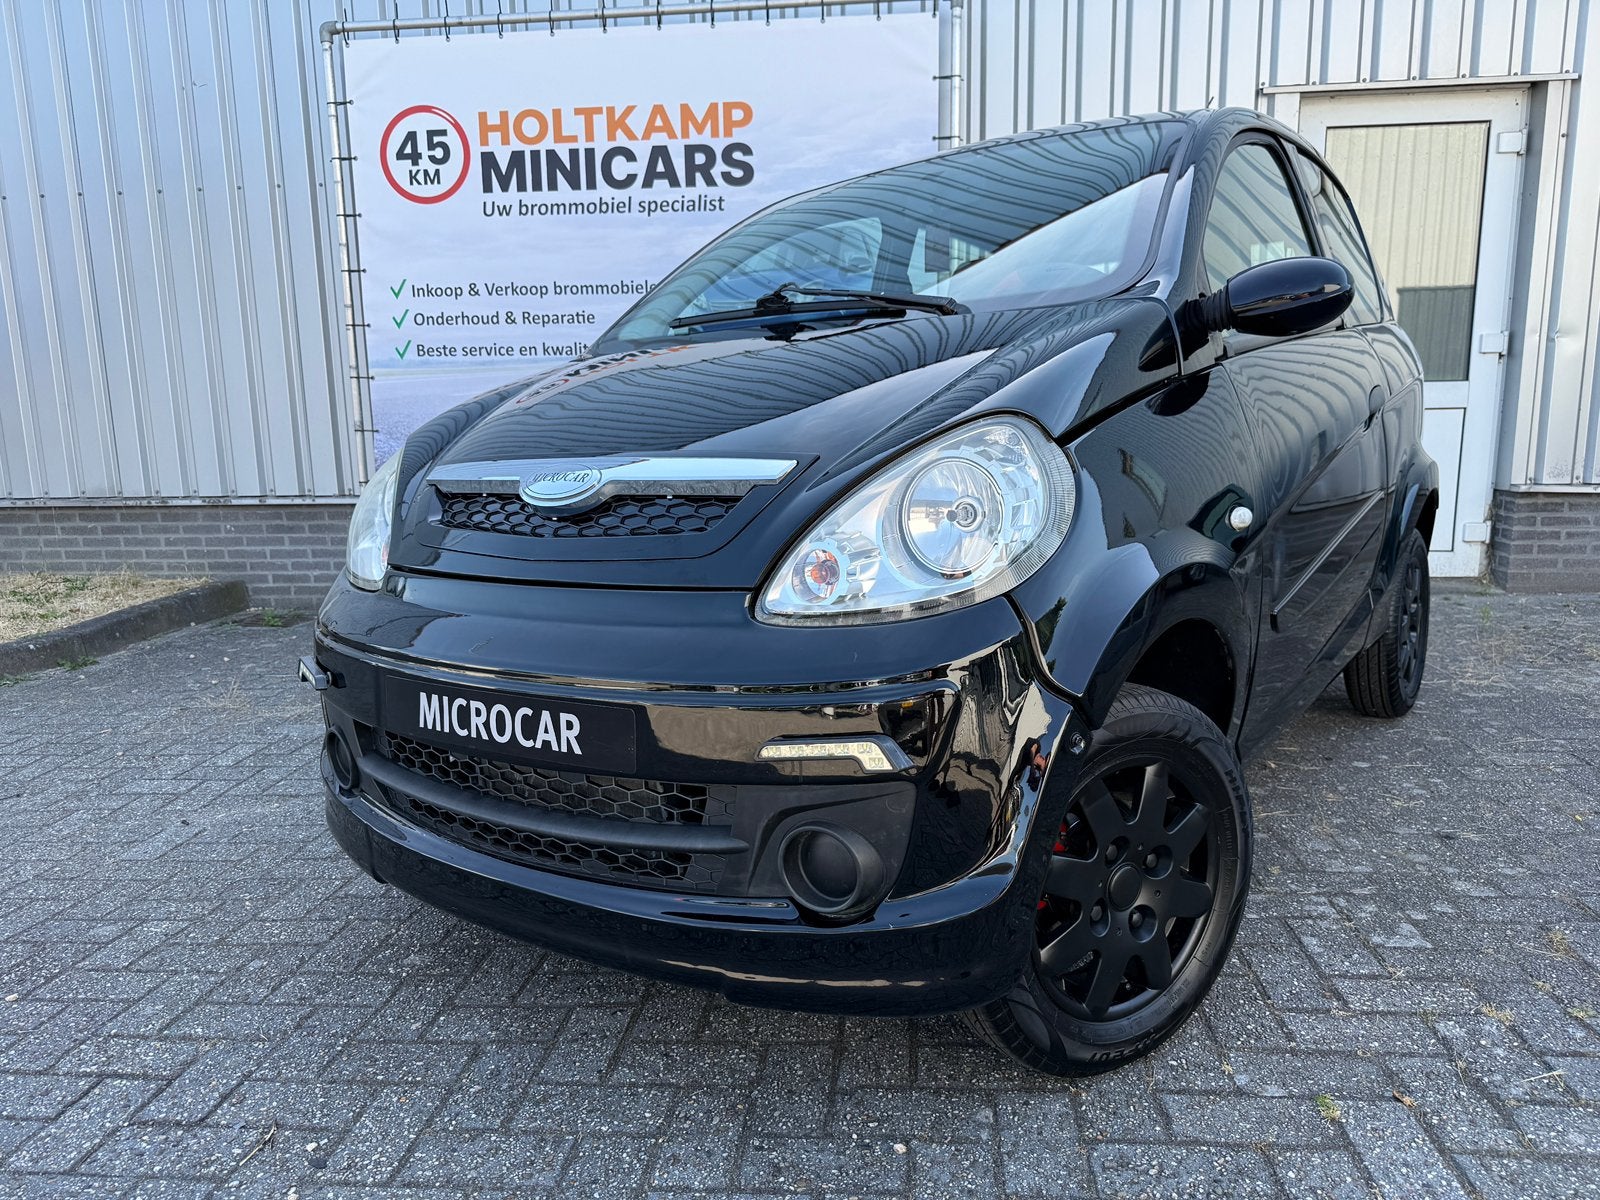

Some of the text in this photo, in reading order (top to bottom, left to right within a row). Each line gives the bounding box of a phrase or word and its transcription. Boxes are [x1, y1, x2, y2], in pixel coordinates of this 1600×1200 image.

[478, 101, 753, 147] HOLTKAMP
[395, 129, 451, 166] 45
[408, 169, 441, 186] KM
[480, 142, 755, 194] MINICARS
[482, 194, 726, 218] Uw brommobiel specialist
[411, 283, 464, 300] Inkoop
[467, 282, 481, 297] &
[484, 281, 549, 299] Verkoop
[413, 309, 596, 328] Onderhoud & Reparatie
[416, 344, 457, 357] Beste
[461, 342, 515, 357] service
[518, 345, 538, 357] en
[418, 691, 583, 755] MICROCAR
